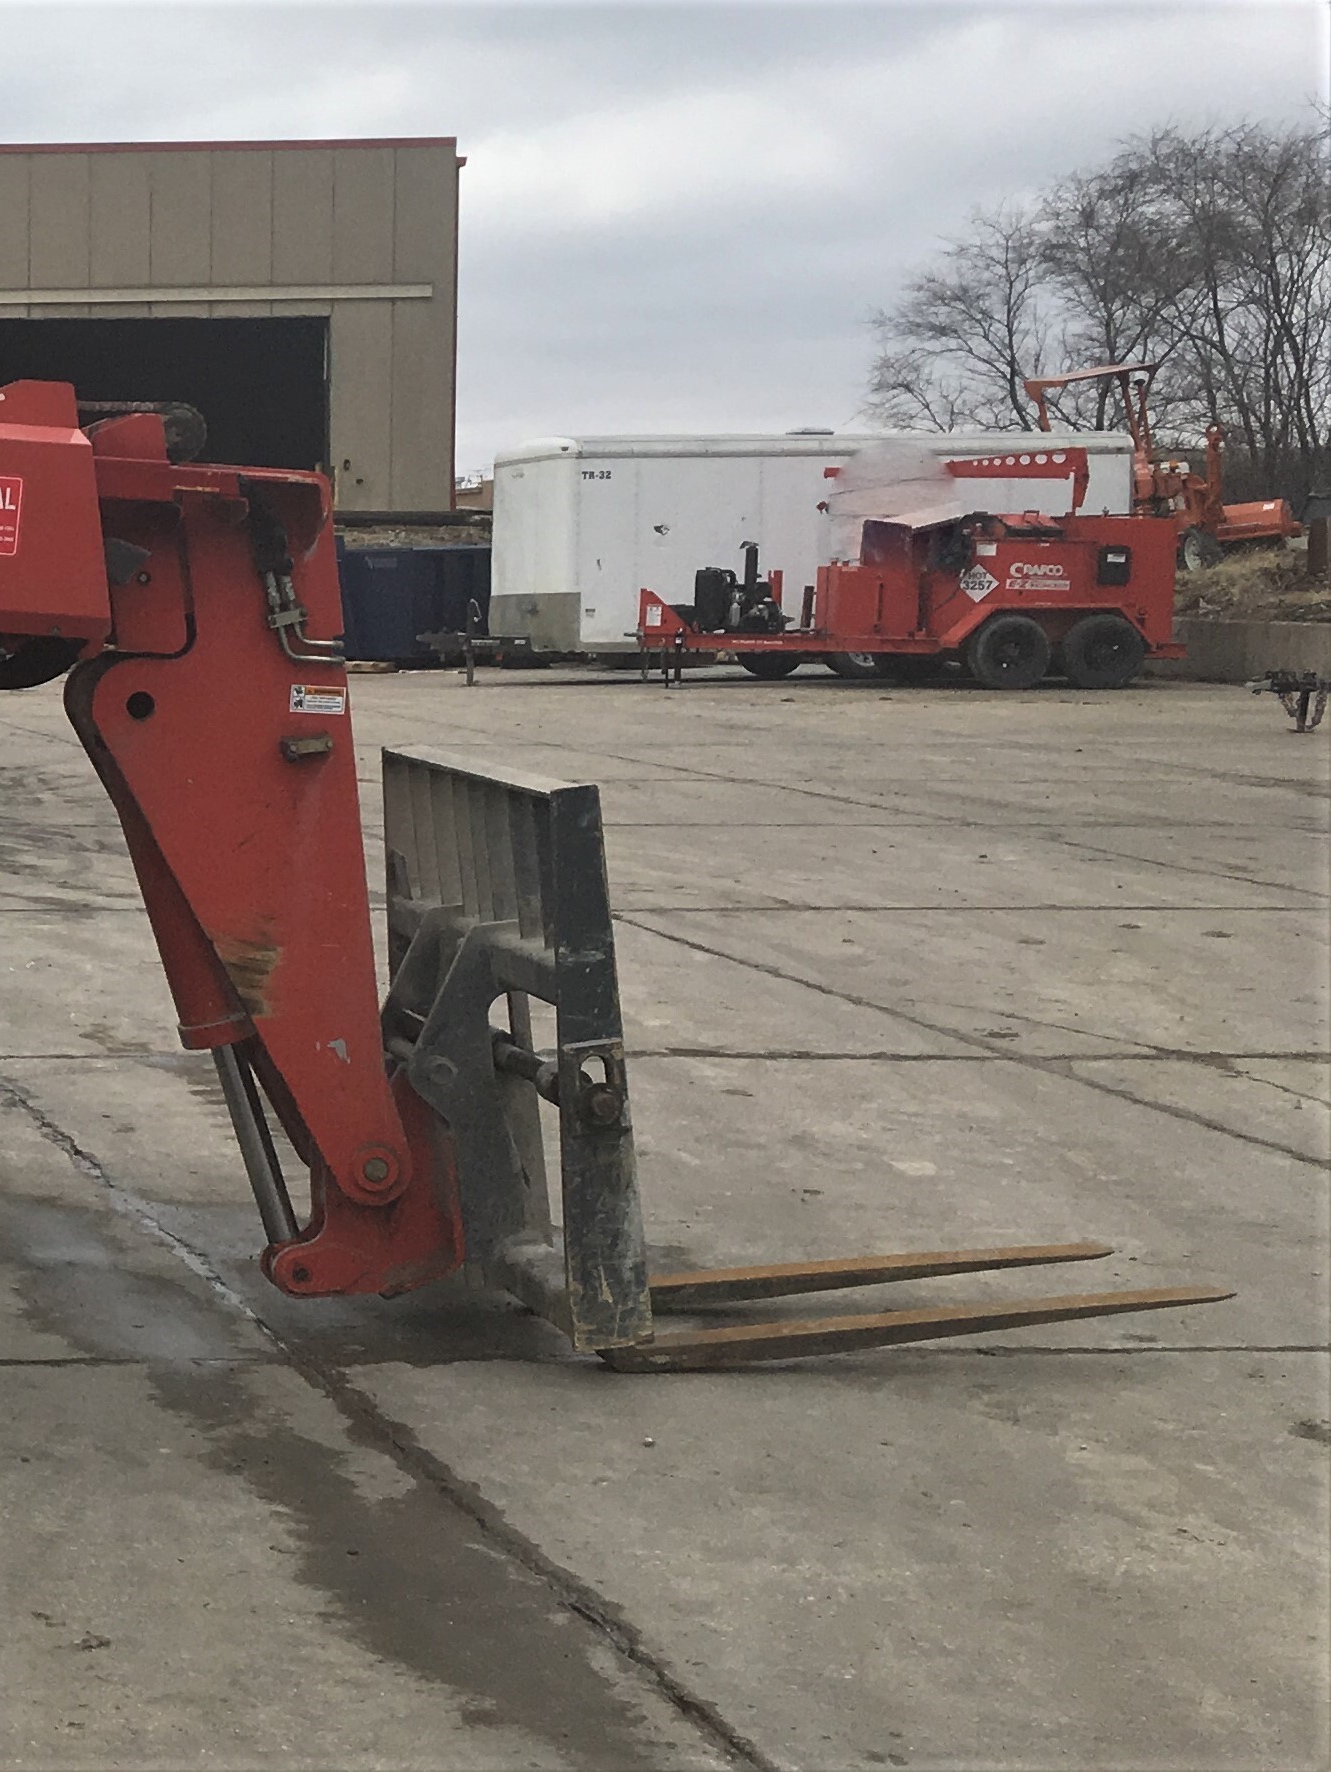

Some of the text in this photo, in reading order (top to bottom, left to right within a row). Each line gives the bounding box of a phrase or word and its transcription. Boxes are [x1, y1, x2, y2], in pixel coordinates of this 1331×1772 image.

[581, 470, 612, 480] TR-32
[968, 571, 987, 580] HOT
[962, 580, 994, 591] 3257
